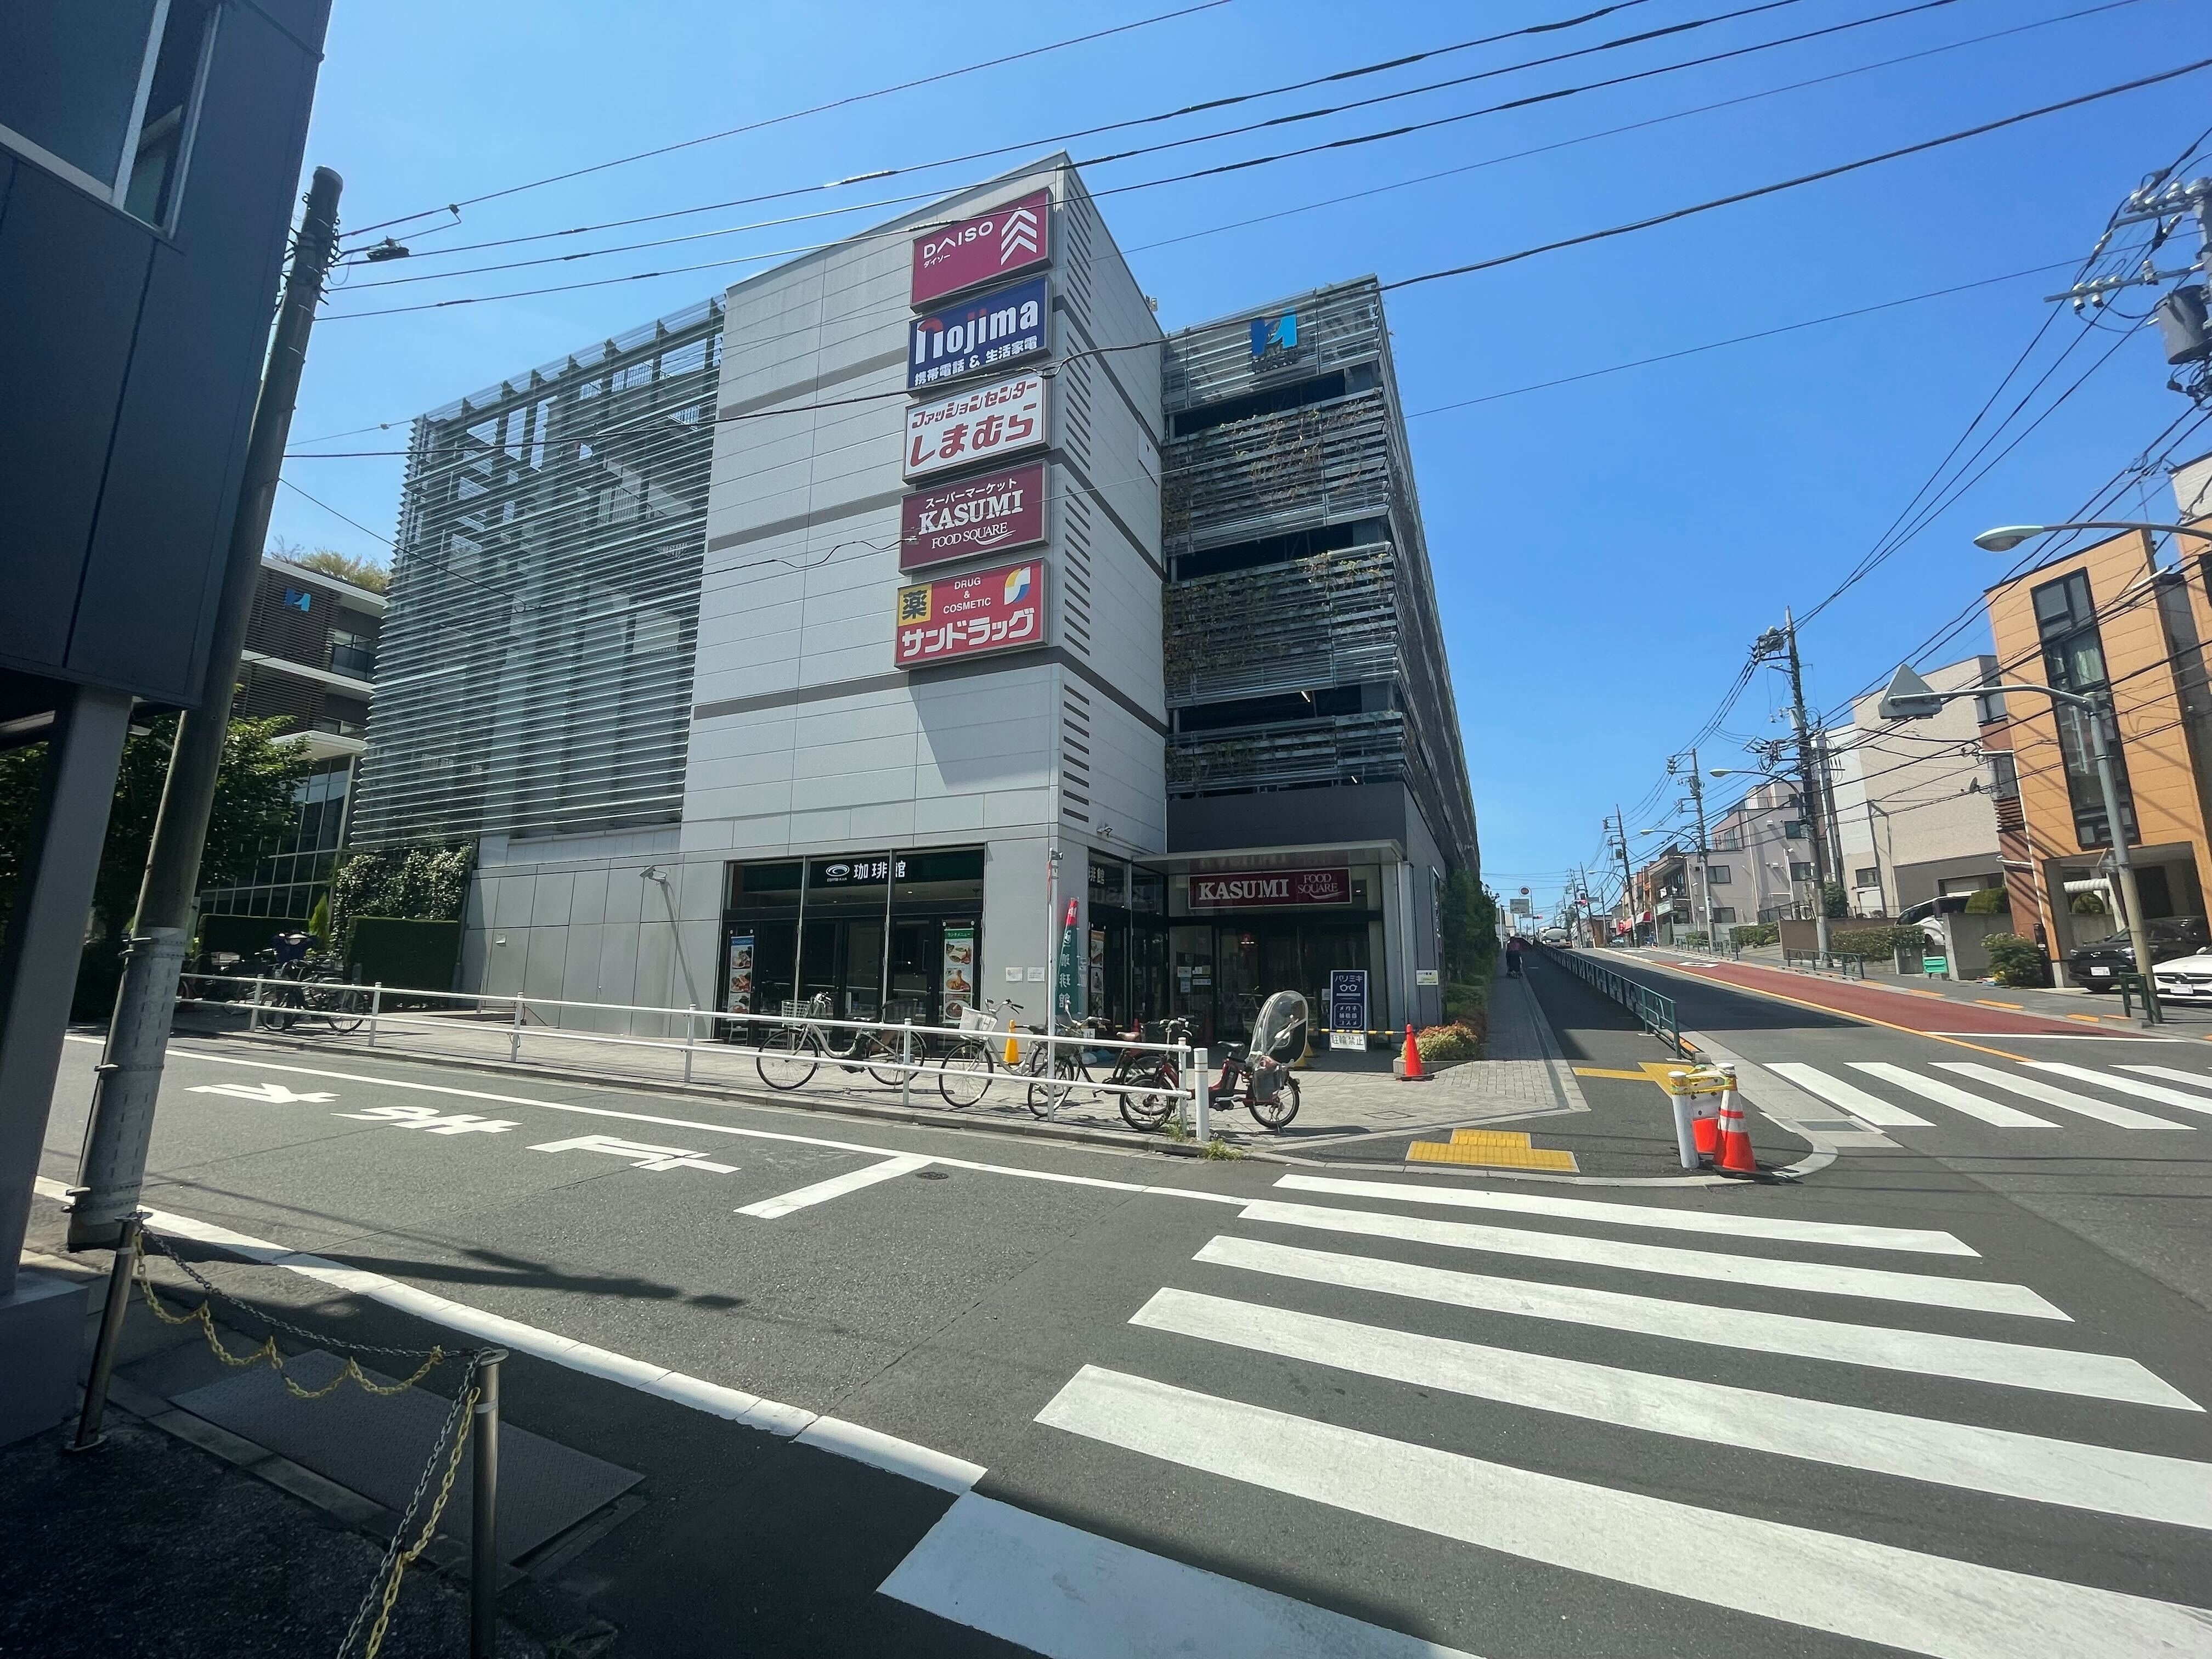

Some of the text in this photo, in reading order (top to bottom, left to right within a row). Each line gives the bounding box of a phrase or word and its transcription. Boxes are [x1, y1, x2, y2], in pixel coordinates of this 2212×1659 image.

[923, 221, 994, 259] DAISO
[923, 253, 951, 268] ダイソー
[915, 335, 1037, 386] 携帯電話 & 生活家電
[912, 381, 1037, 428] ファッションセンター
[910, 403, 1037, 467] しまむら
[926, 478, 1017, 509] スーパーマーケット
[918, 489, 1024, 535] KASUMI
[932, 522, 1008, 549] FOOD SQUARE
[954, 577, 981, 590] DRUG
[963, 590, 970, 599] &
[902, 589, 928, 620] 薬
[943, 597, 991, 614] COSMETIC
[902, 607, 1035, 657] サンドラッグ
[1199, 879, 1289, 900] KASUMI
[1297, 883, 1339, 895] SQUARE
[1304, 873, 1332, 883] FOOD
[1331, 1035, 1364, 1046] 駐輪禁止
